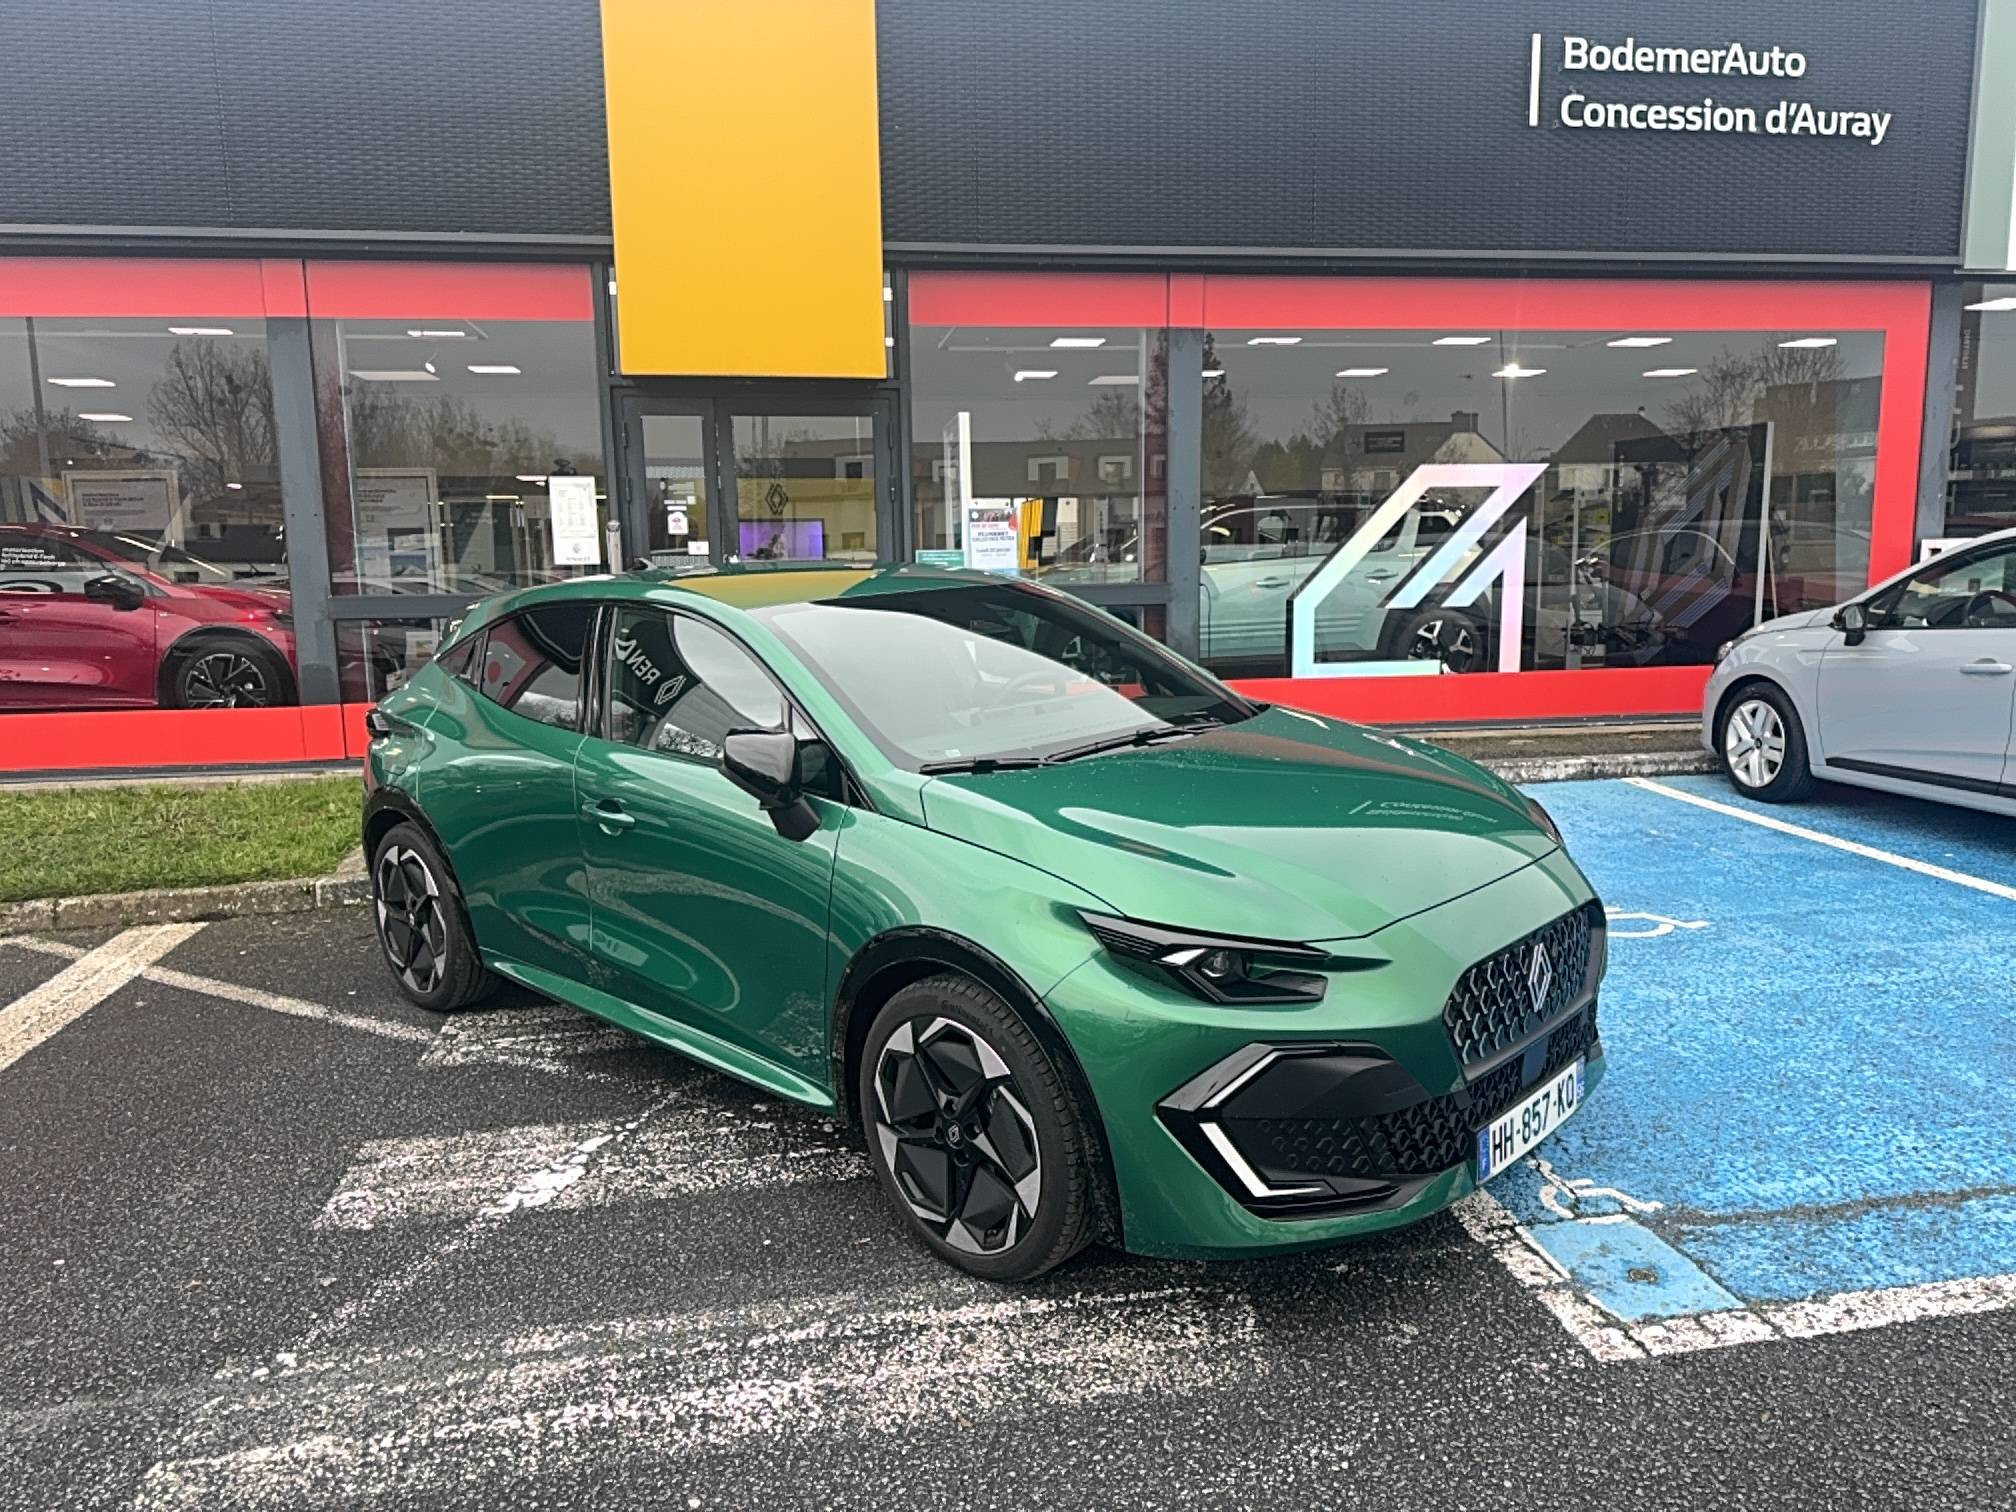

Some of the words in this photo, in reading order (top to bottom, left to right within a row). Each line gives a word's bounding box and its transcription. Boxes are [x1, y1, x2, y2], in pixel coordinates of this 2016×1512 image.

[1563, 36, 1807, 77] BodemerAuto
[1560, 94, 1757, 133] Concession
[1764, 101, 1892, 146] d'Auray
